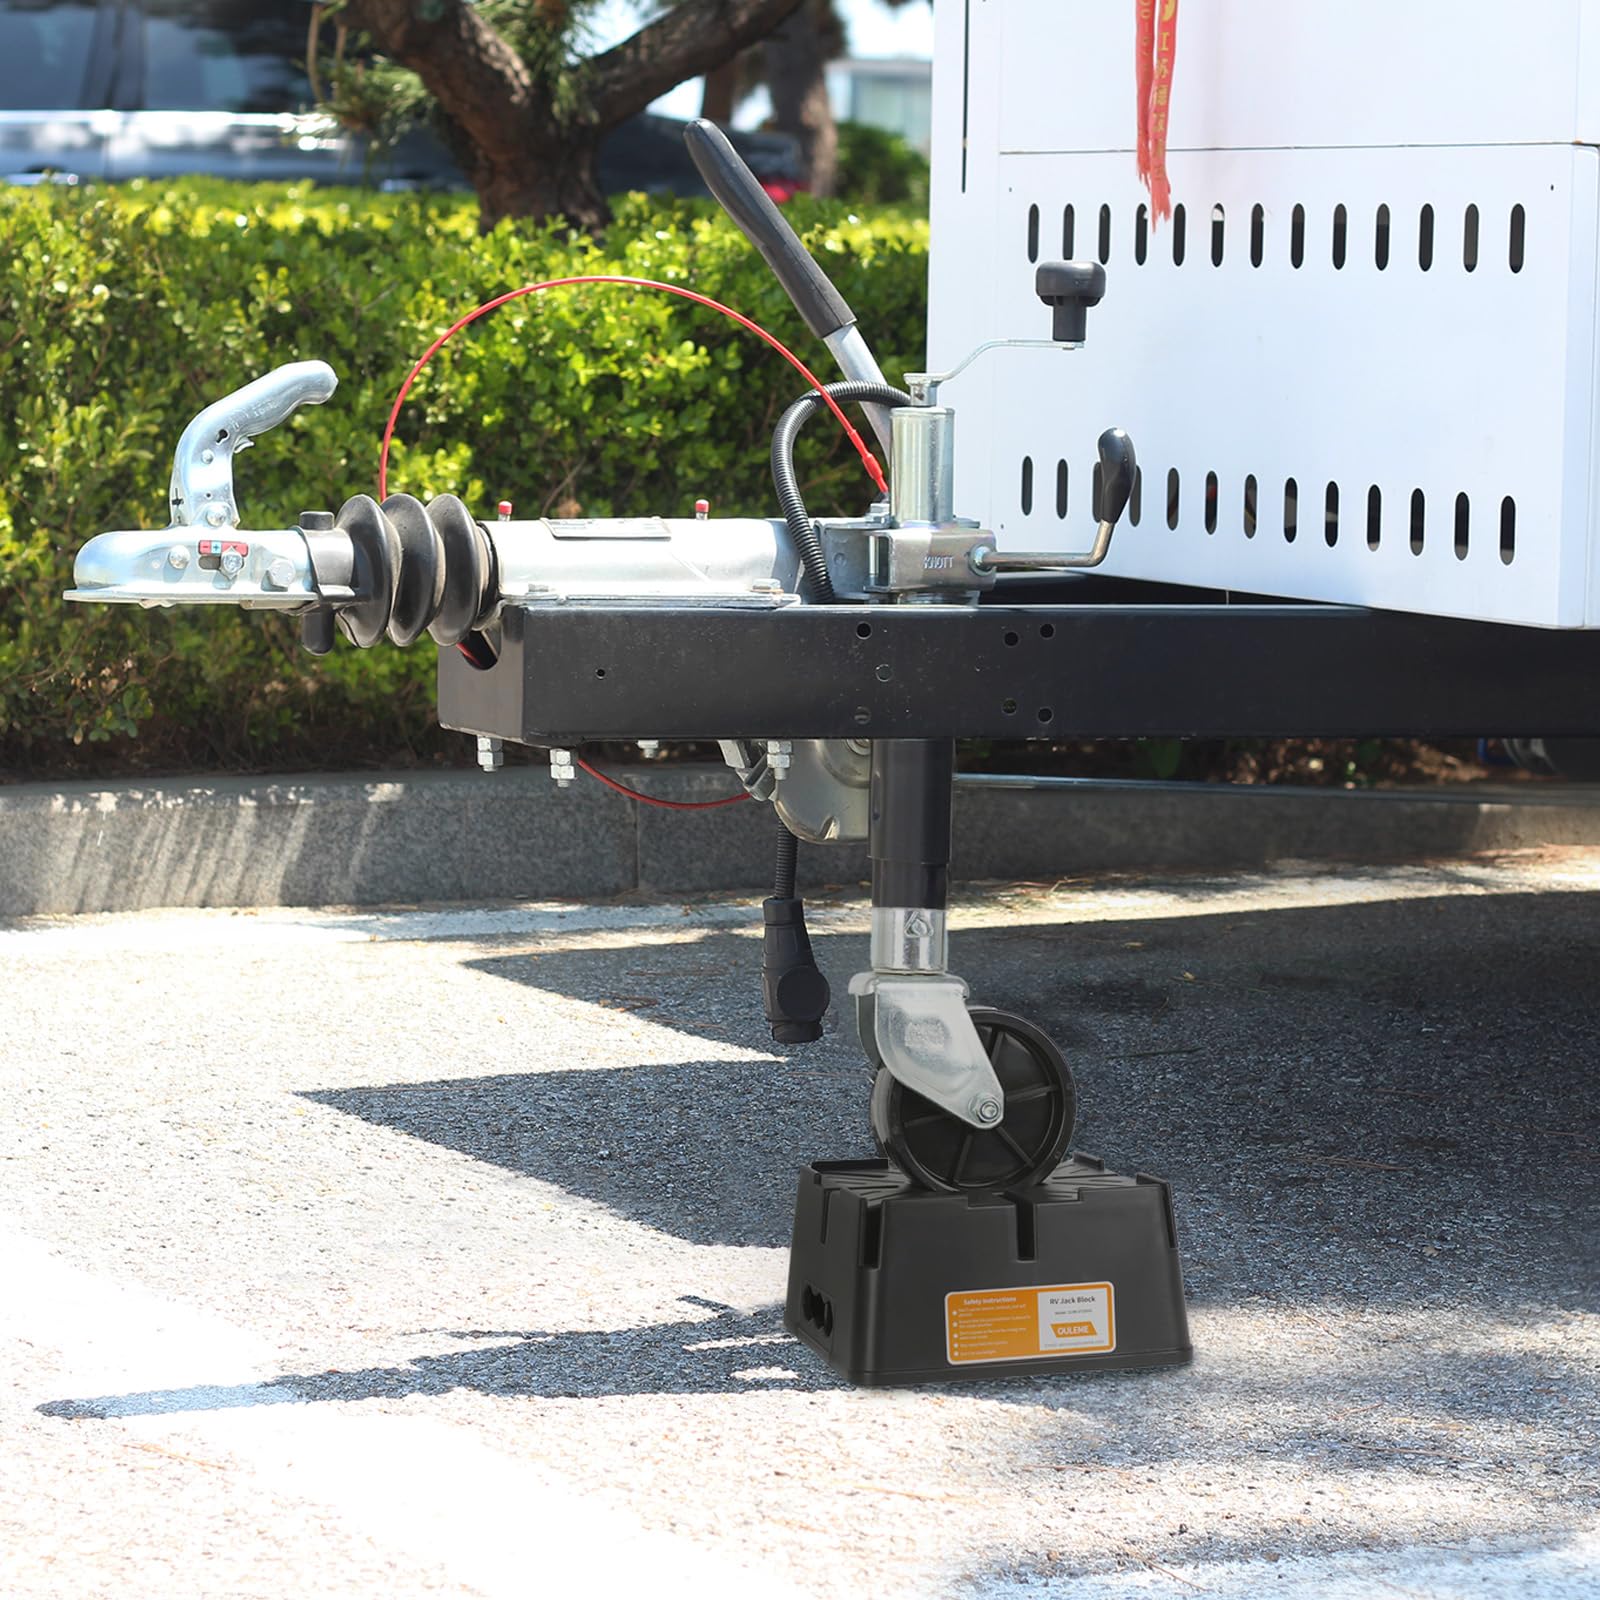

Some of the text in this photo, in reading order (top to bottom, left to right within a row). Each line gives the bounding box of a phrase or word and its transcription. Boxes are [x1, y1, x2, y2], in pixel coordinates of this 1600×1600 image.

[923, 556, 953, 569] KNOTT
[963, 1298, 982, 1306] Safety
[1077, 1295, 1096, 1303] Block
